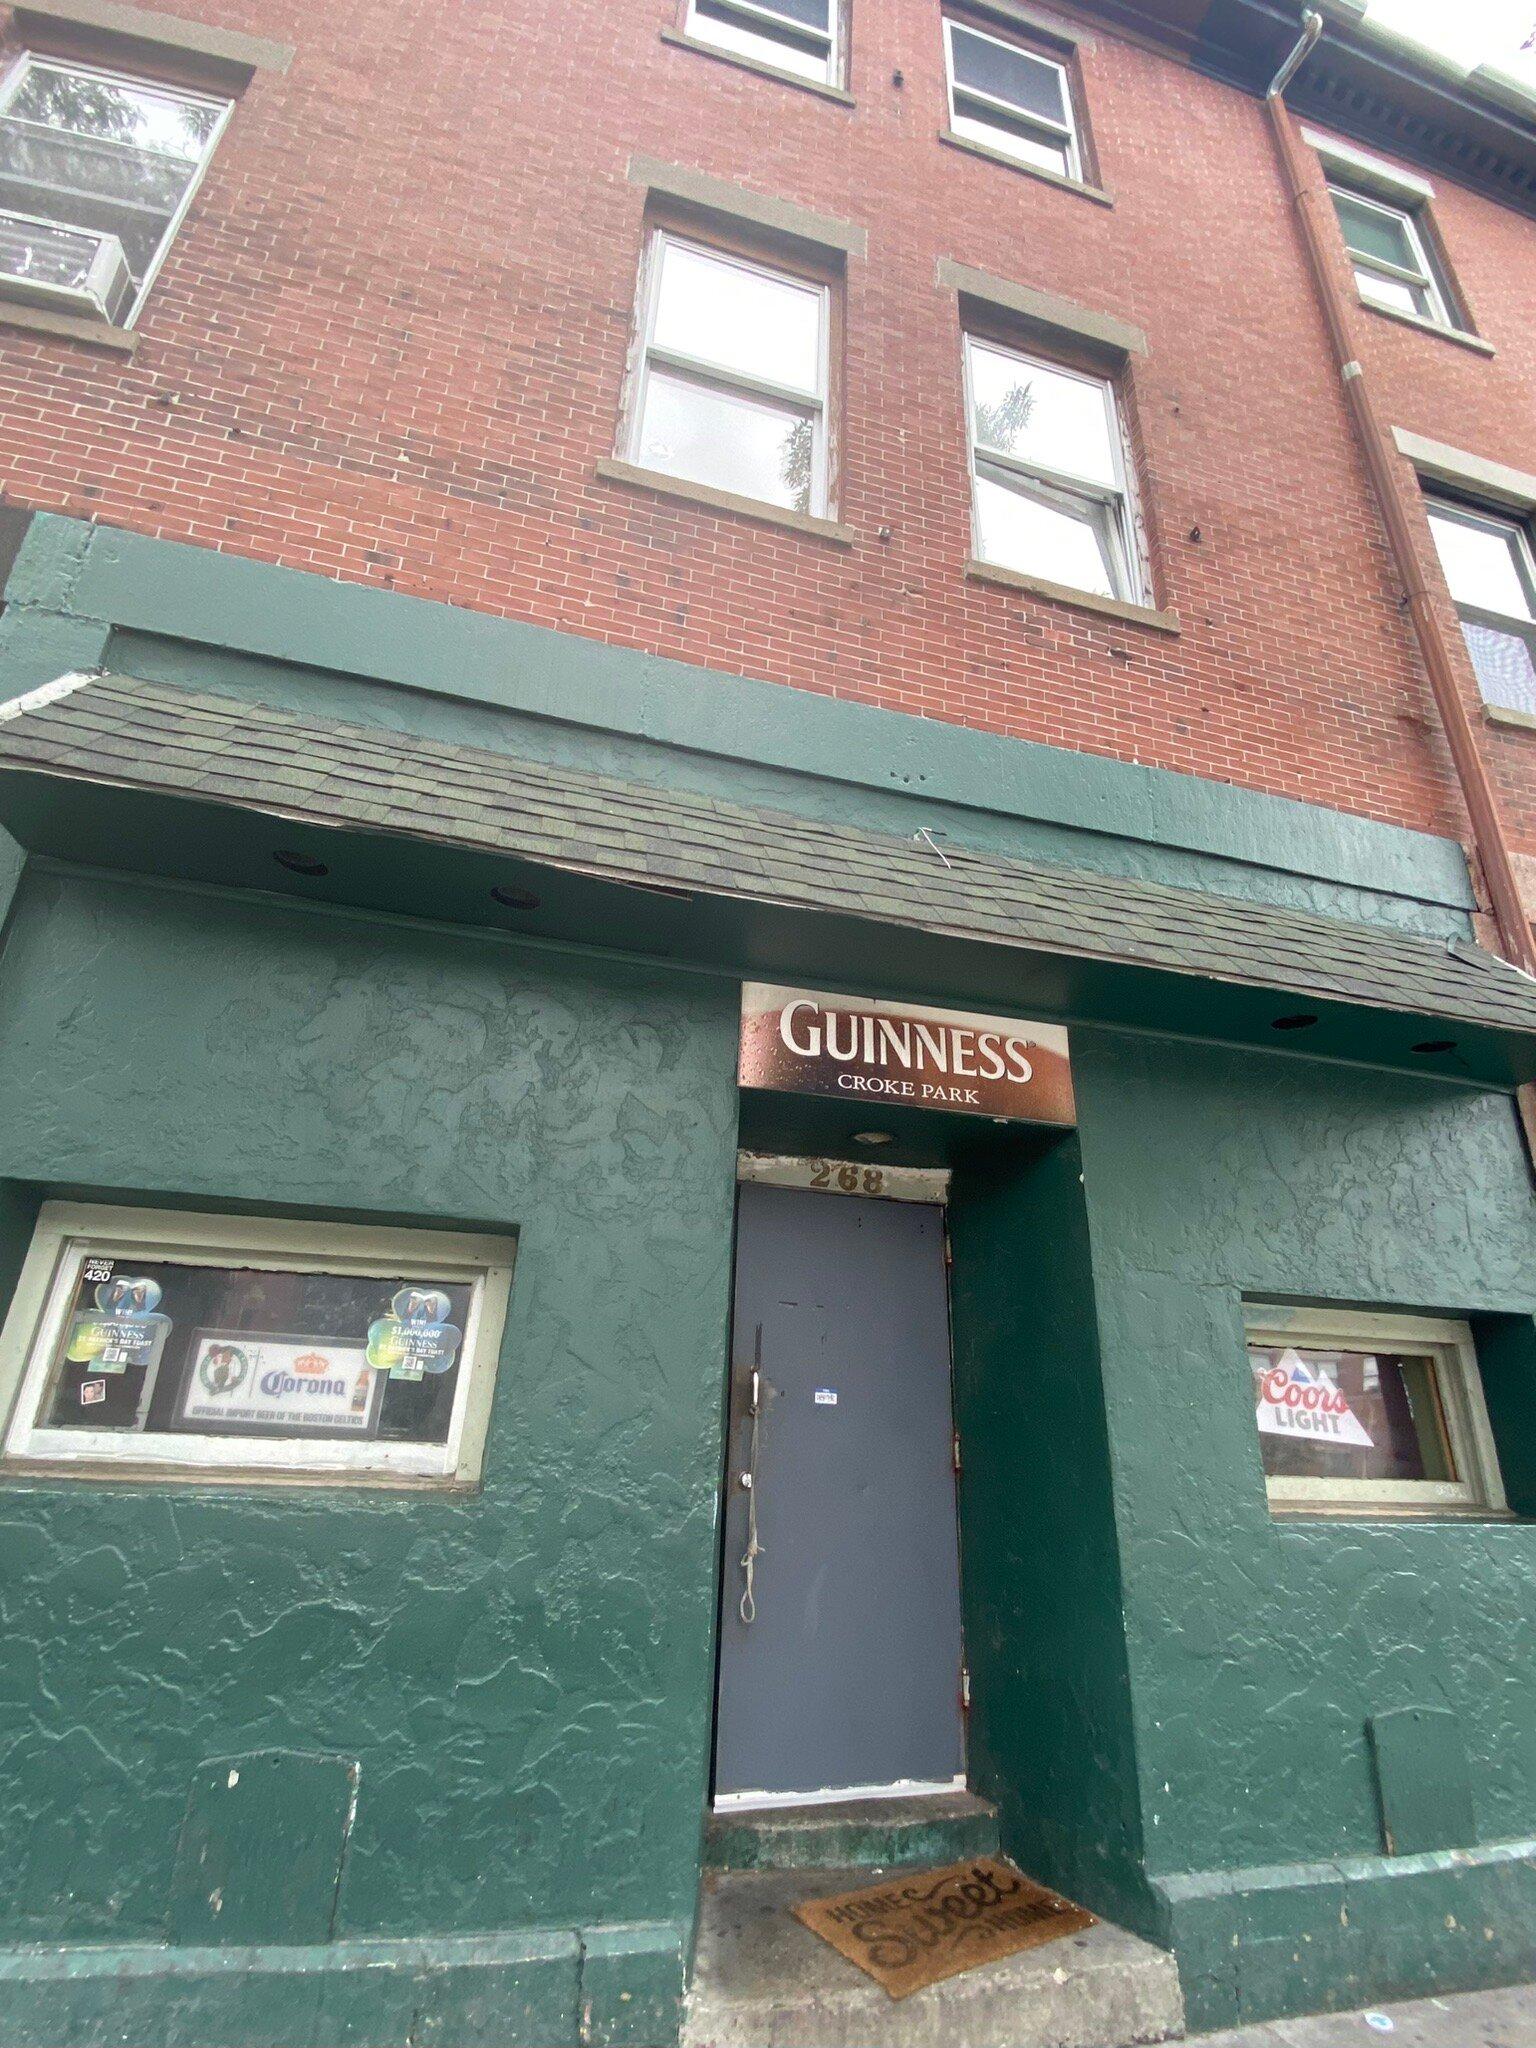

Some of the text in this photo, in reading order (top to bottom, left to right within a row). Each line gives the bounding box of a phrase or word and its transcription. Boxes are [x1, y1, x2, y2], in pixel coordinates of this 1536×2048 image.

[779, 999, 1034, 1084] GUINNESS
[837, 1074, 981, 1105] CROKE PARK
[809, 1162, 885, 1195] 268
[84, 1270, 111, 1282] 420
[91, 1327, 144, 1340] GUINNESS
[390, 1335, 438, 1349] GUINNESS
[260, 1370, 347, 1398] Corona
[1258, 1368, 1350, 1414] Coors
[192, 1405, 224, 1417] OFFICIAL
[225, 1408, 256, 1419] IMPORT
[256, 1409, 276, 1420] BEER
[276, 1411, 286, 1421] OF
[303, 1412, 334, 1424] BOSTON
[334, 1414, 364, 1426] CELTICS
[1274, 1406, 1341, 1434] LIGHT
[851, 1867, 1020, 1968] Sweet
